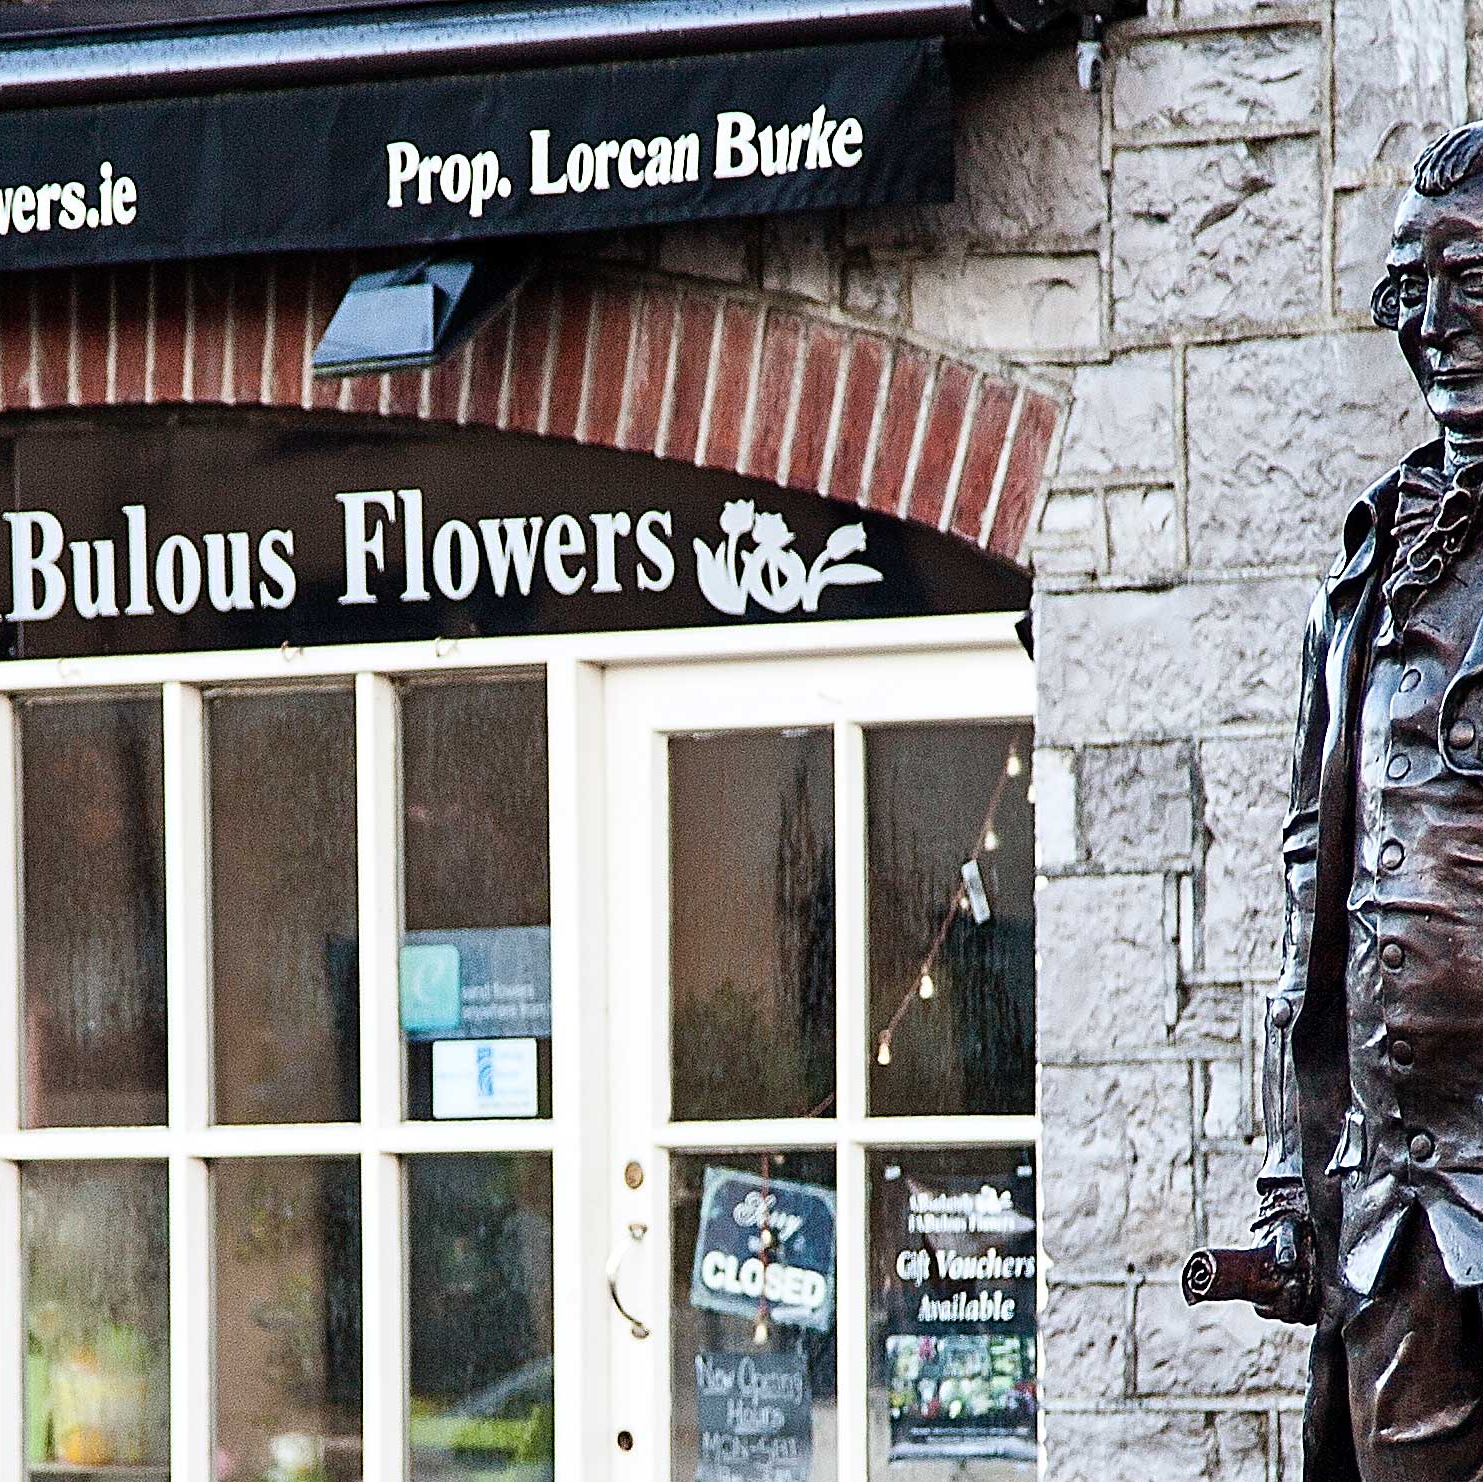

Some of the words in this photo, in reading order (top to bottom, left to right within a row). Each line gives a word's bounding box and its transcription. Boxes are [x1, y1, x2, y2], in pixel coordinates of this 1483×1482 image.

[387, 142, 511, 217] Prop.
[530, 129, 700, 195] Lorcan
[714, 105, 863, 179] Burke
[335, 489, 675, 604] Flowers
[701, 1249, 826, 1310] CLOSED
[896, 1248, 931, 1288] Gift
[935, 1246, 1036, 1281] Vouchers
[916, 1290, 1016, 1322] Available
